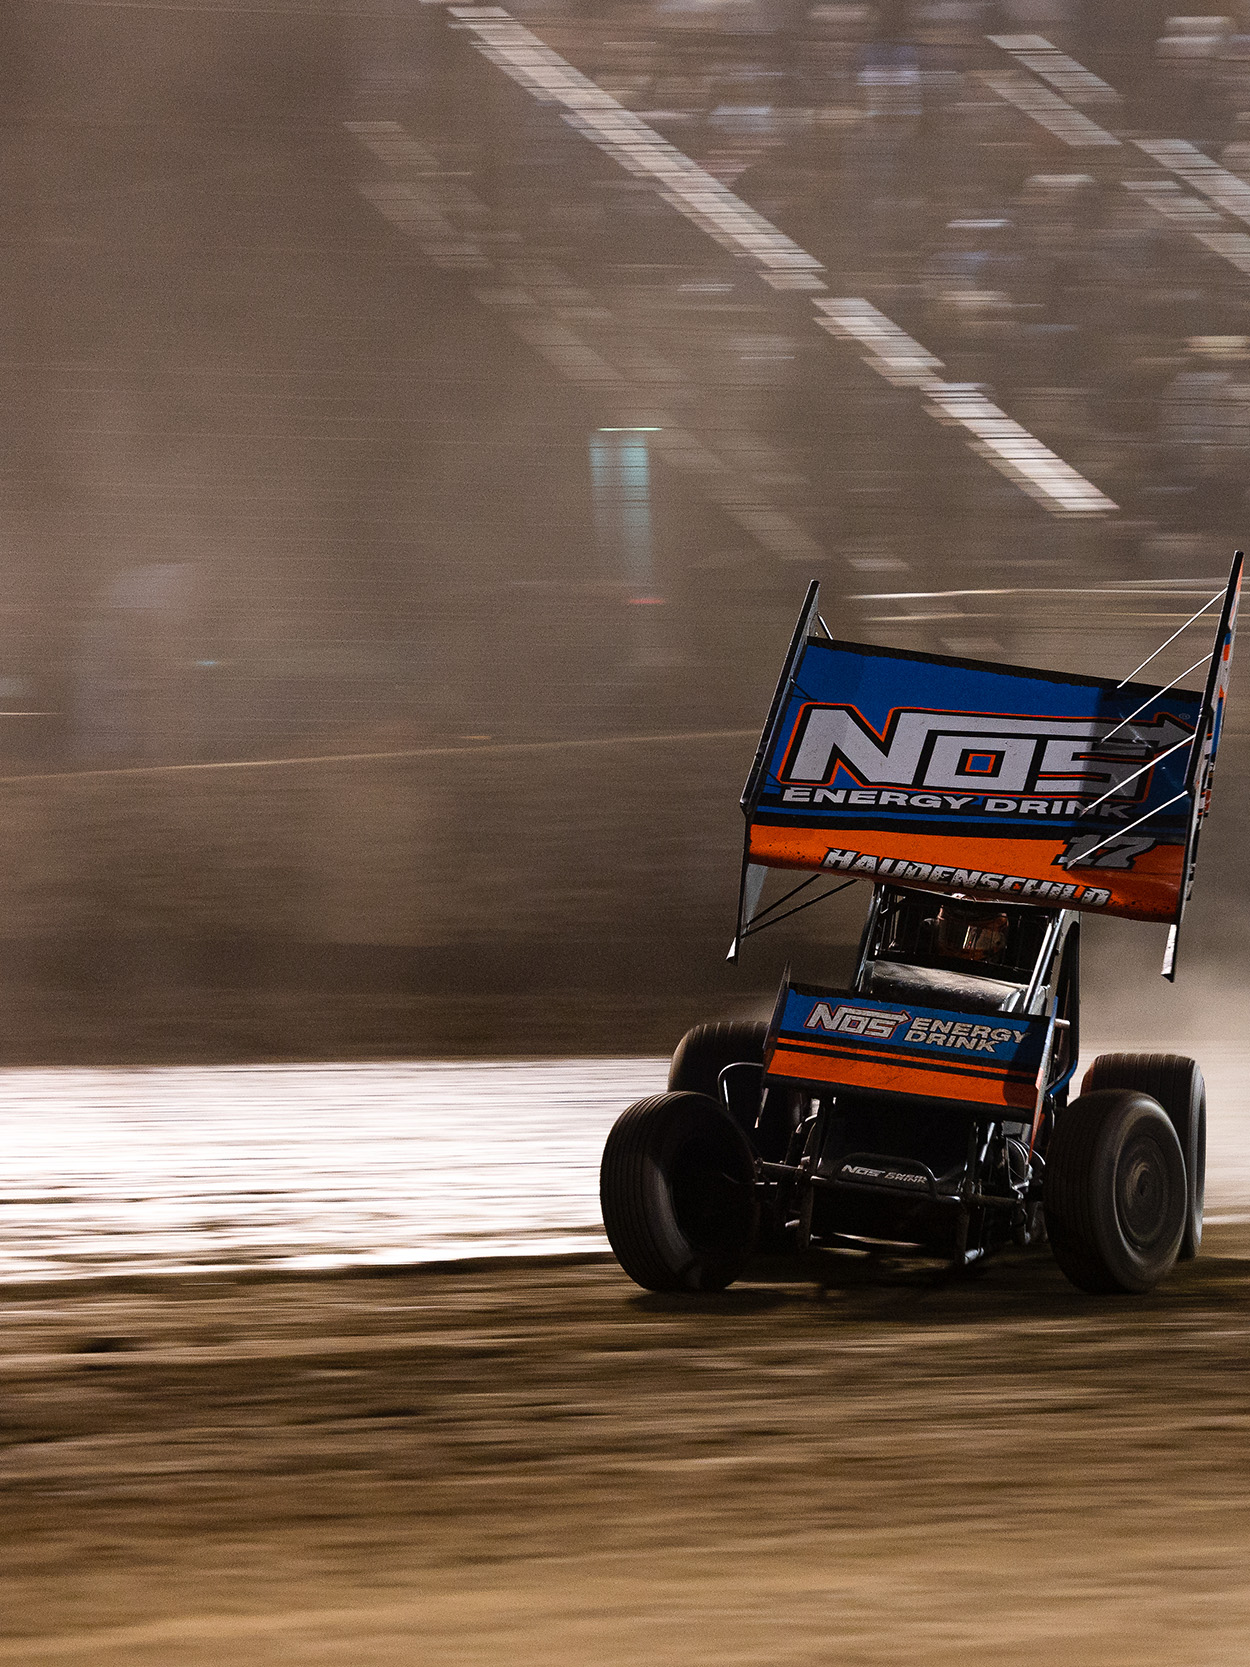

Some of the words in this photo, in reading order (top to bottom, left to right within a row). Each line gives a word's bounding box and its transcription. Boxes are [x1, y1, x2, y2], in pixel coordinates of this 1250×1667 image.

[780, 704, 1194, 800] NOS
[782, 787, 976, 811] ENERGY
[984, 797, 1136, 820] DRINK
[1054, 834, 1157, 870] 17
[821, 847, 1113, 907] HAUDENSCHILD
[804, 1002, 911, 1039] NOS
[909, 1016, 1032, 1044] ENERGY
[903, 1029, 999, 1053] DRINK
[841, 1164, 885, 1178] NOS
